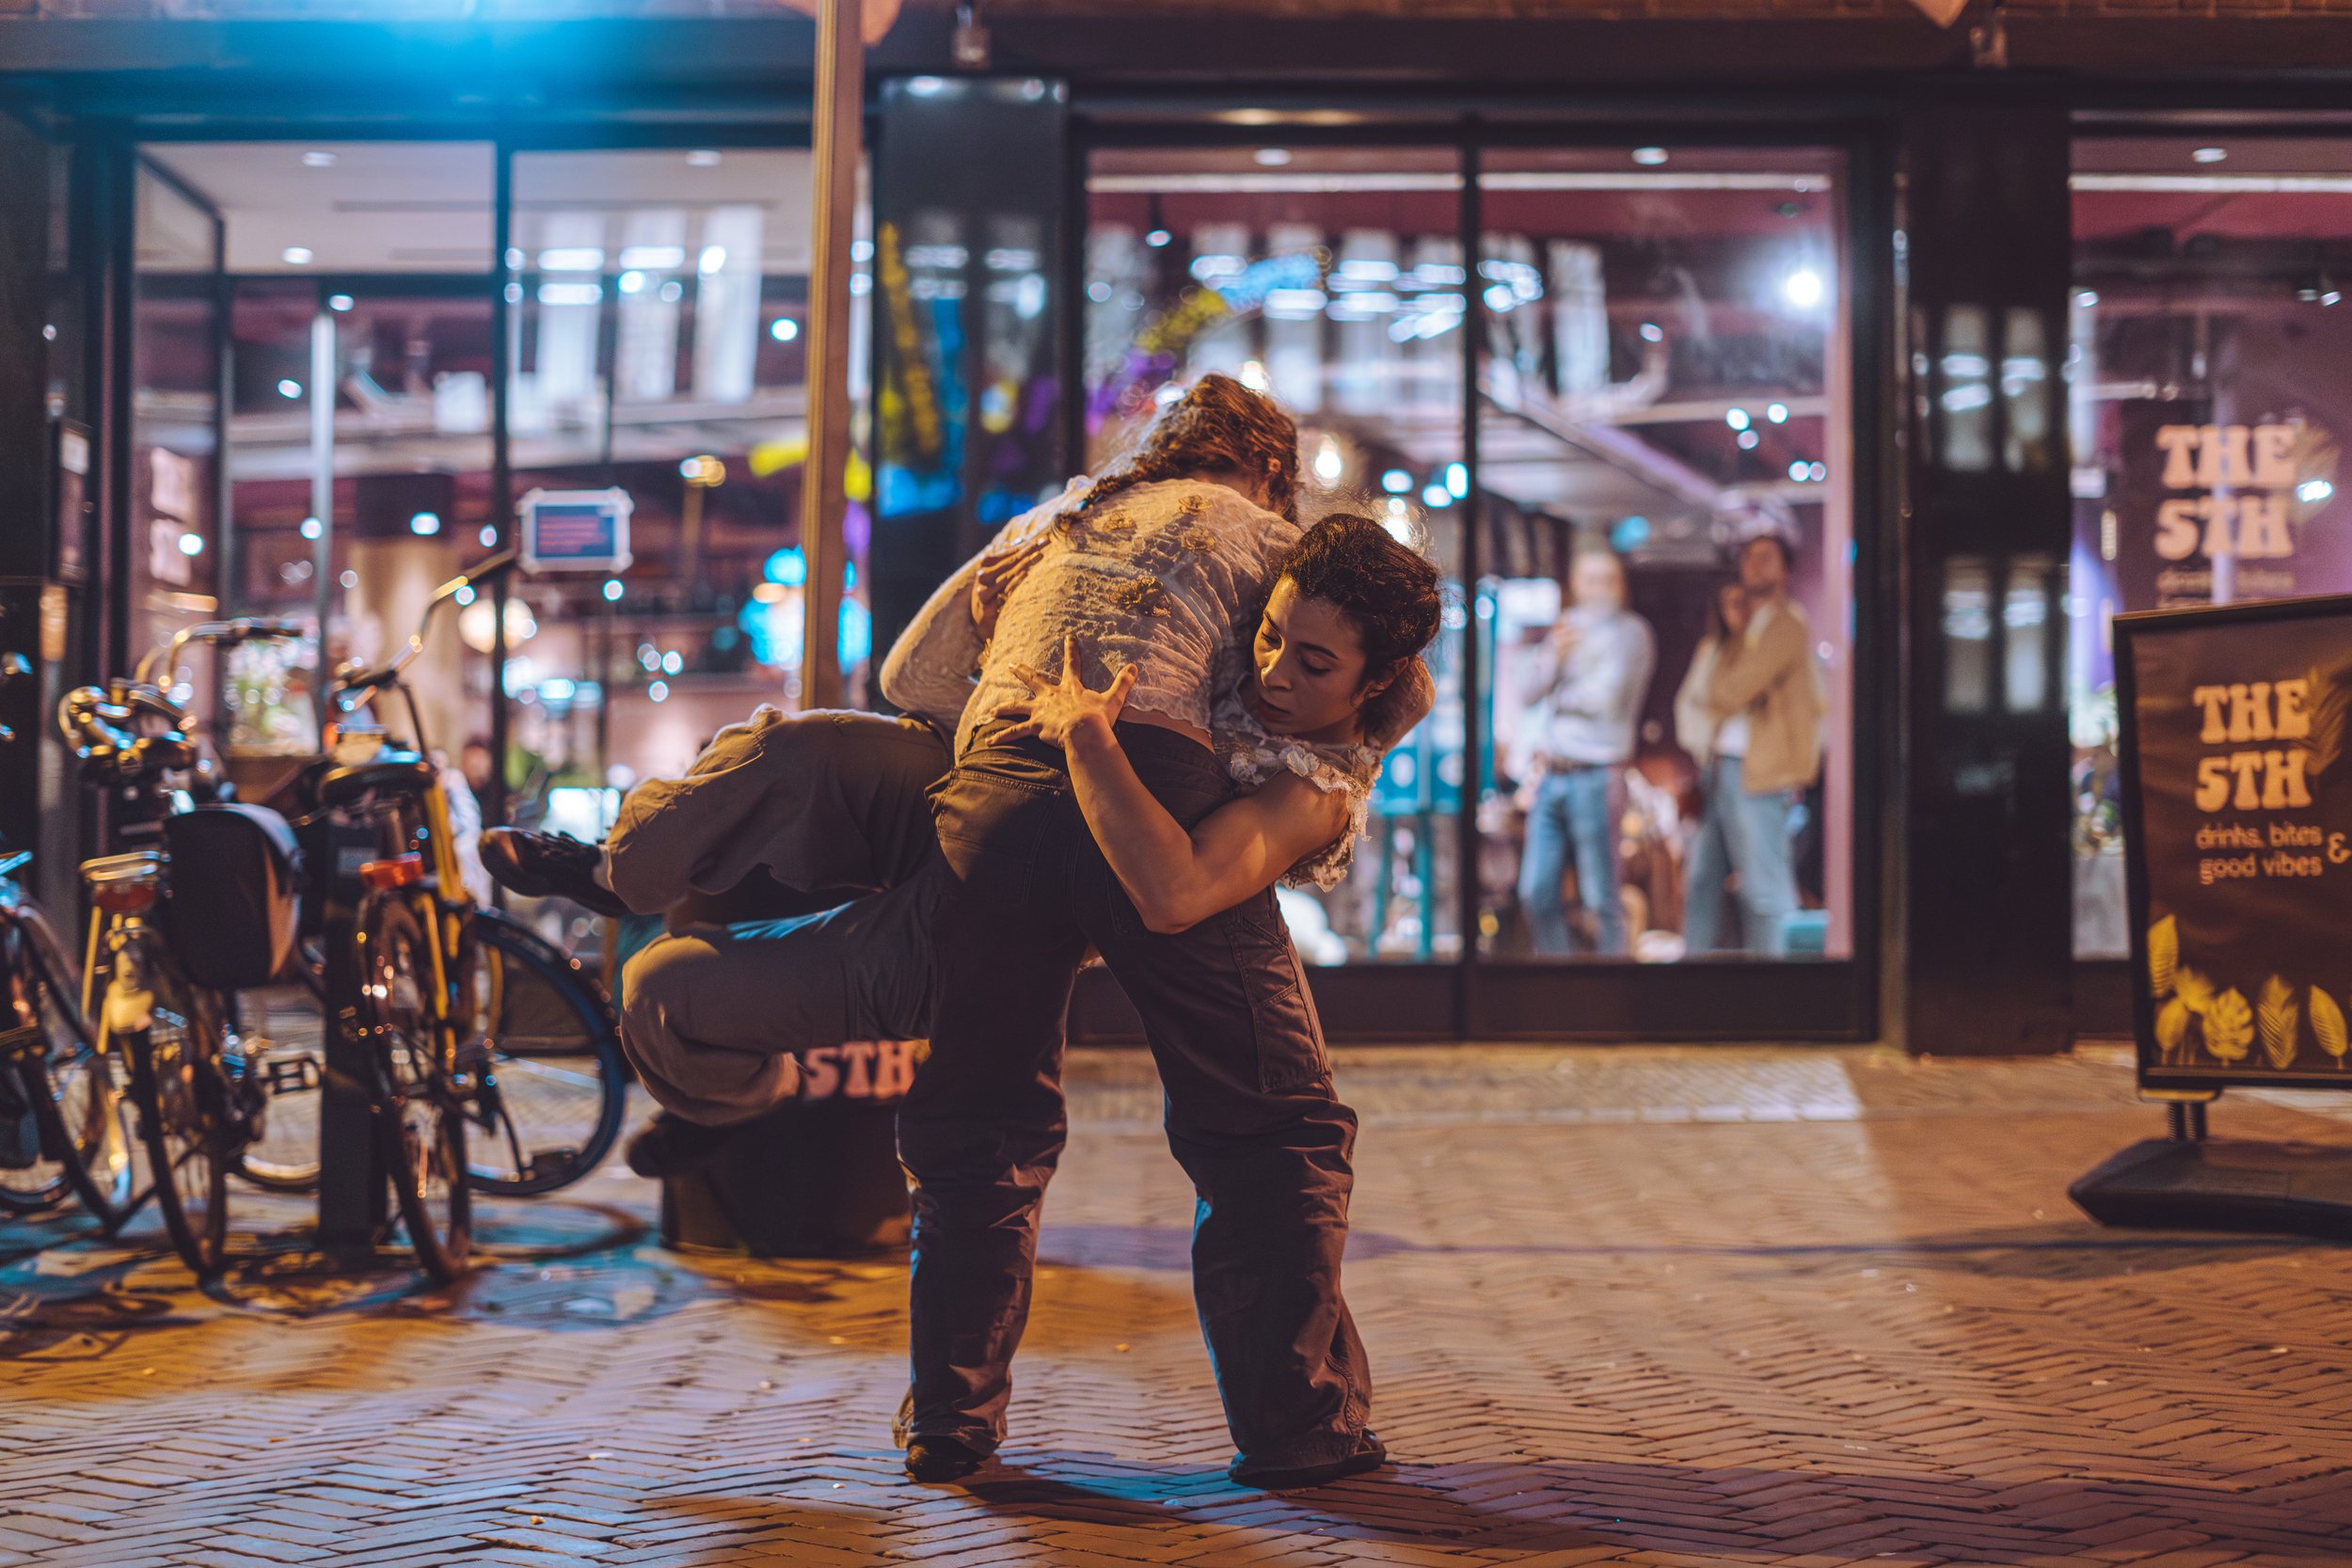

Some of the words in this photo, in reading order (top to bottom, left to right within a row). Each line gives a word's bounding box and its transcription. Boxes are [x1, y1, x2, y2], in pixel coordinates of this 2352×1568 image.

[2156, 424, 2296, 488] THE
[2193, 679, 2310, 741] THE
[2269, 820, 2323, 847] bites
[2328, 832, 2351, 863] &
[2199, 852, 2257, 885] good
[2261, 851, 2323, 877] vibes
